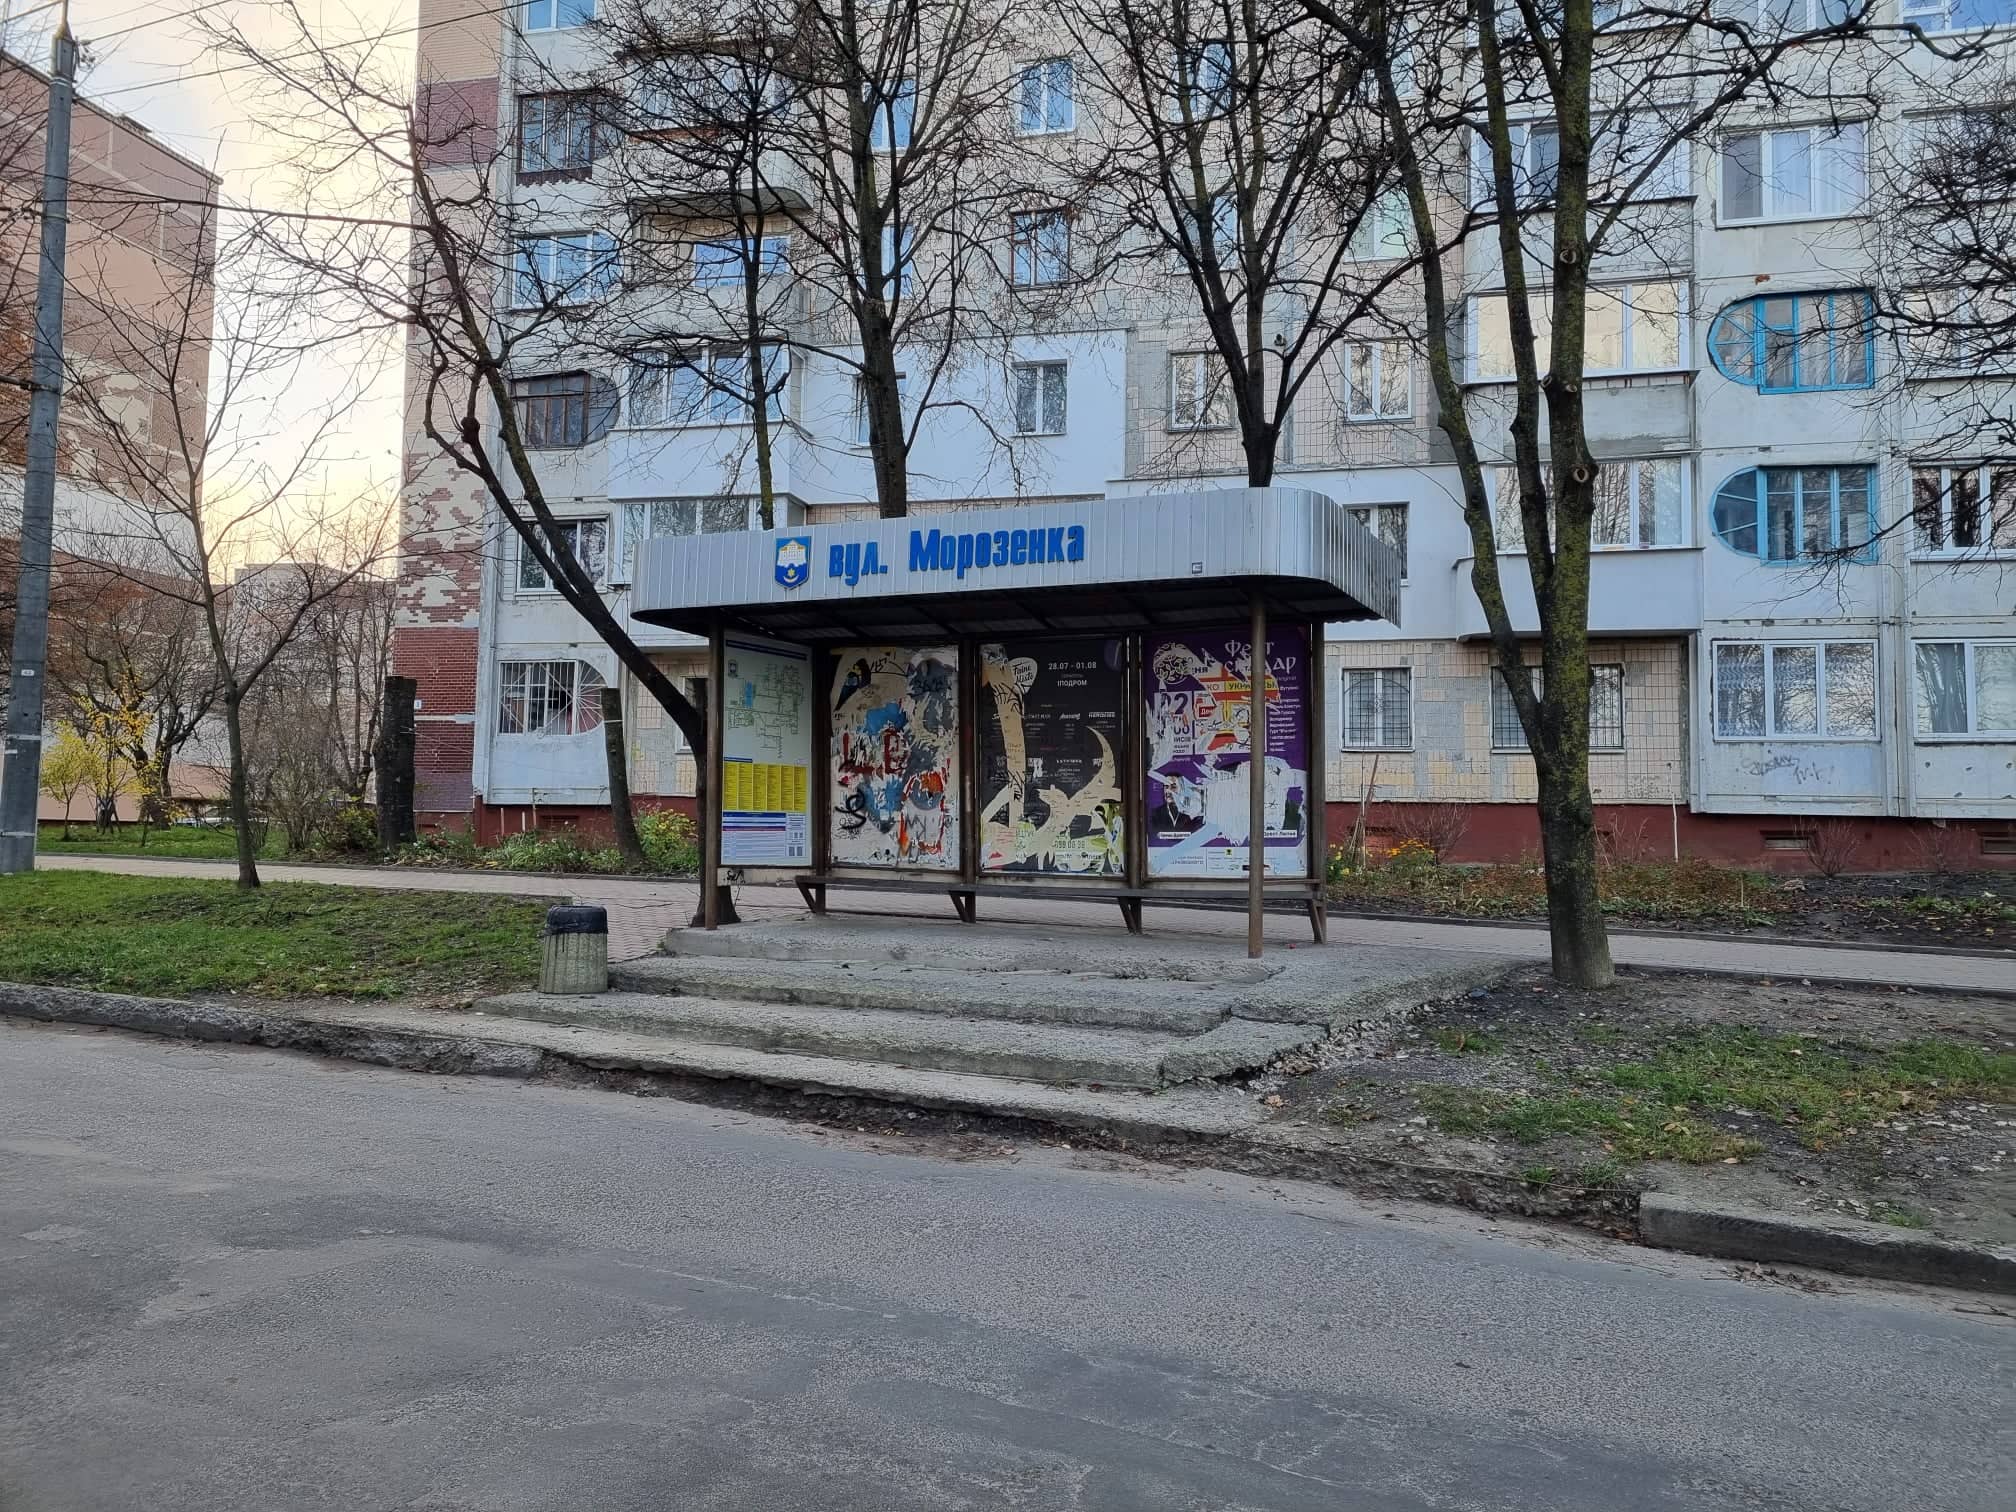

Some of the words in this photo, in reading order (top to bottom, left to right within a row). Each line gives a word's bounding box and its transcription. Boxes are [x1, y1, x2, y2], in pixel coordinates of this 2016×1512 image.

[829, 541, 888, 587] вул.
[909, 525, 1085, 580] Морозенка
[1224, 640, 1274, 657] Фет
[1048, 662, 1069, 670] 28.07
[1075, 661, 1096, 670] 01.08
